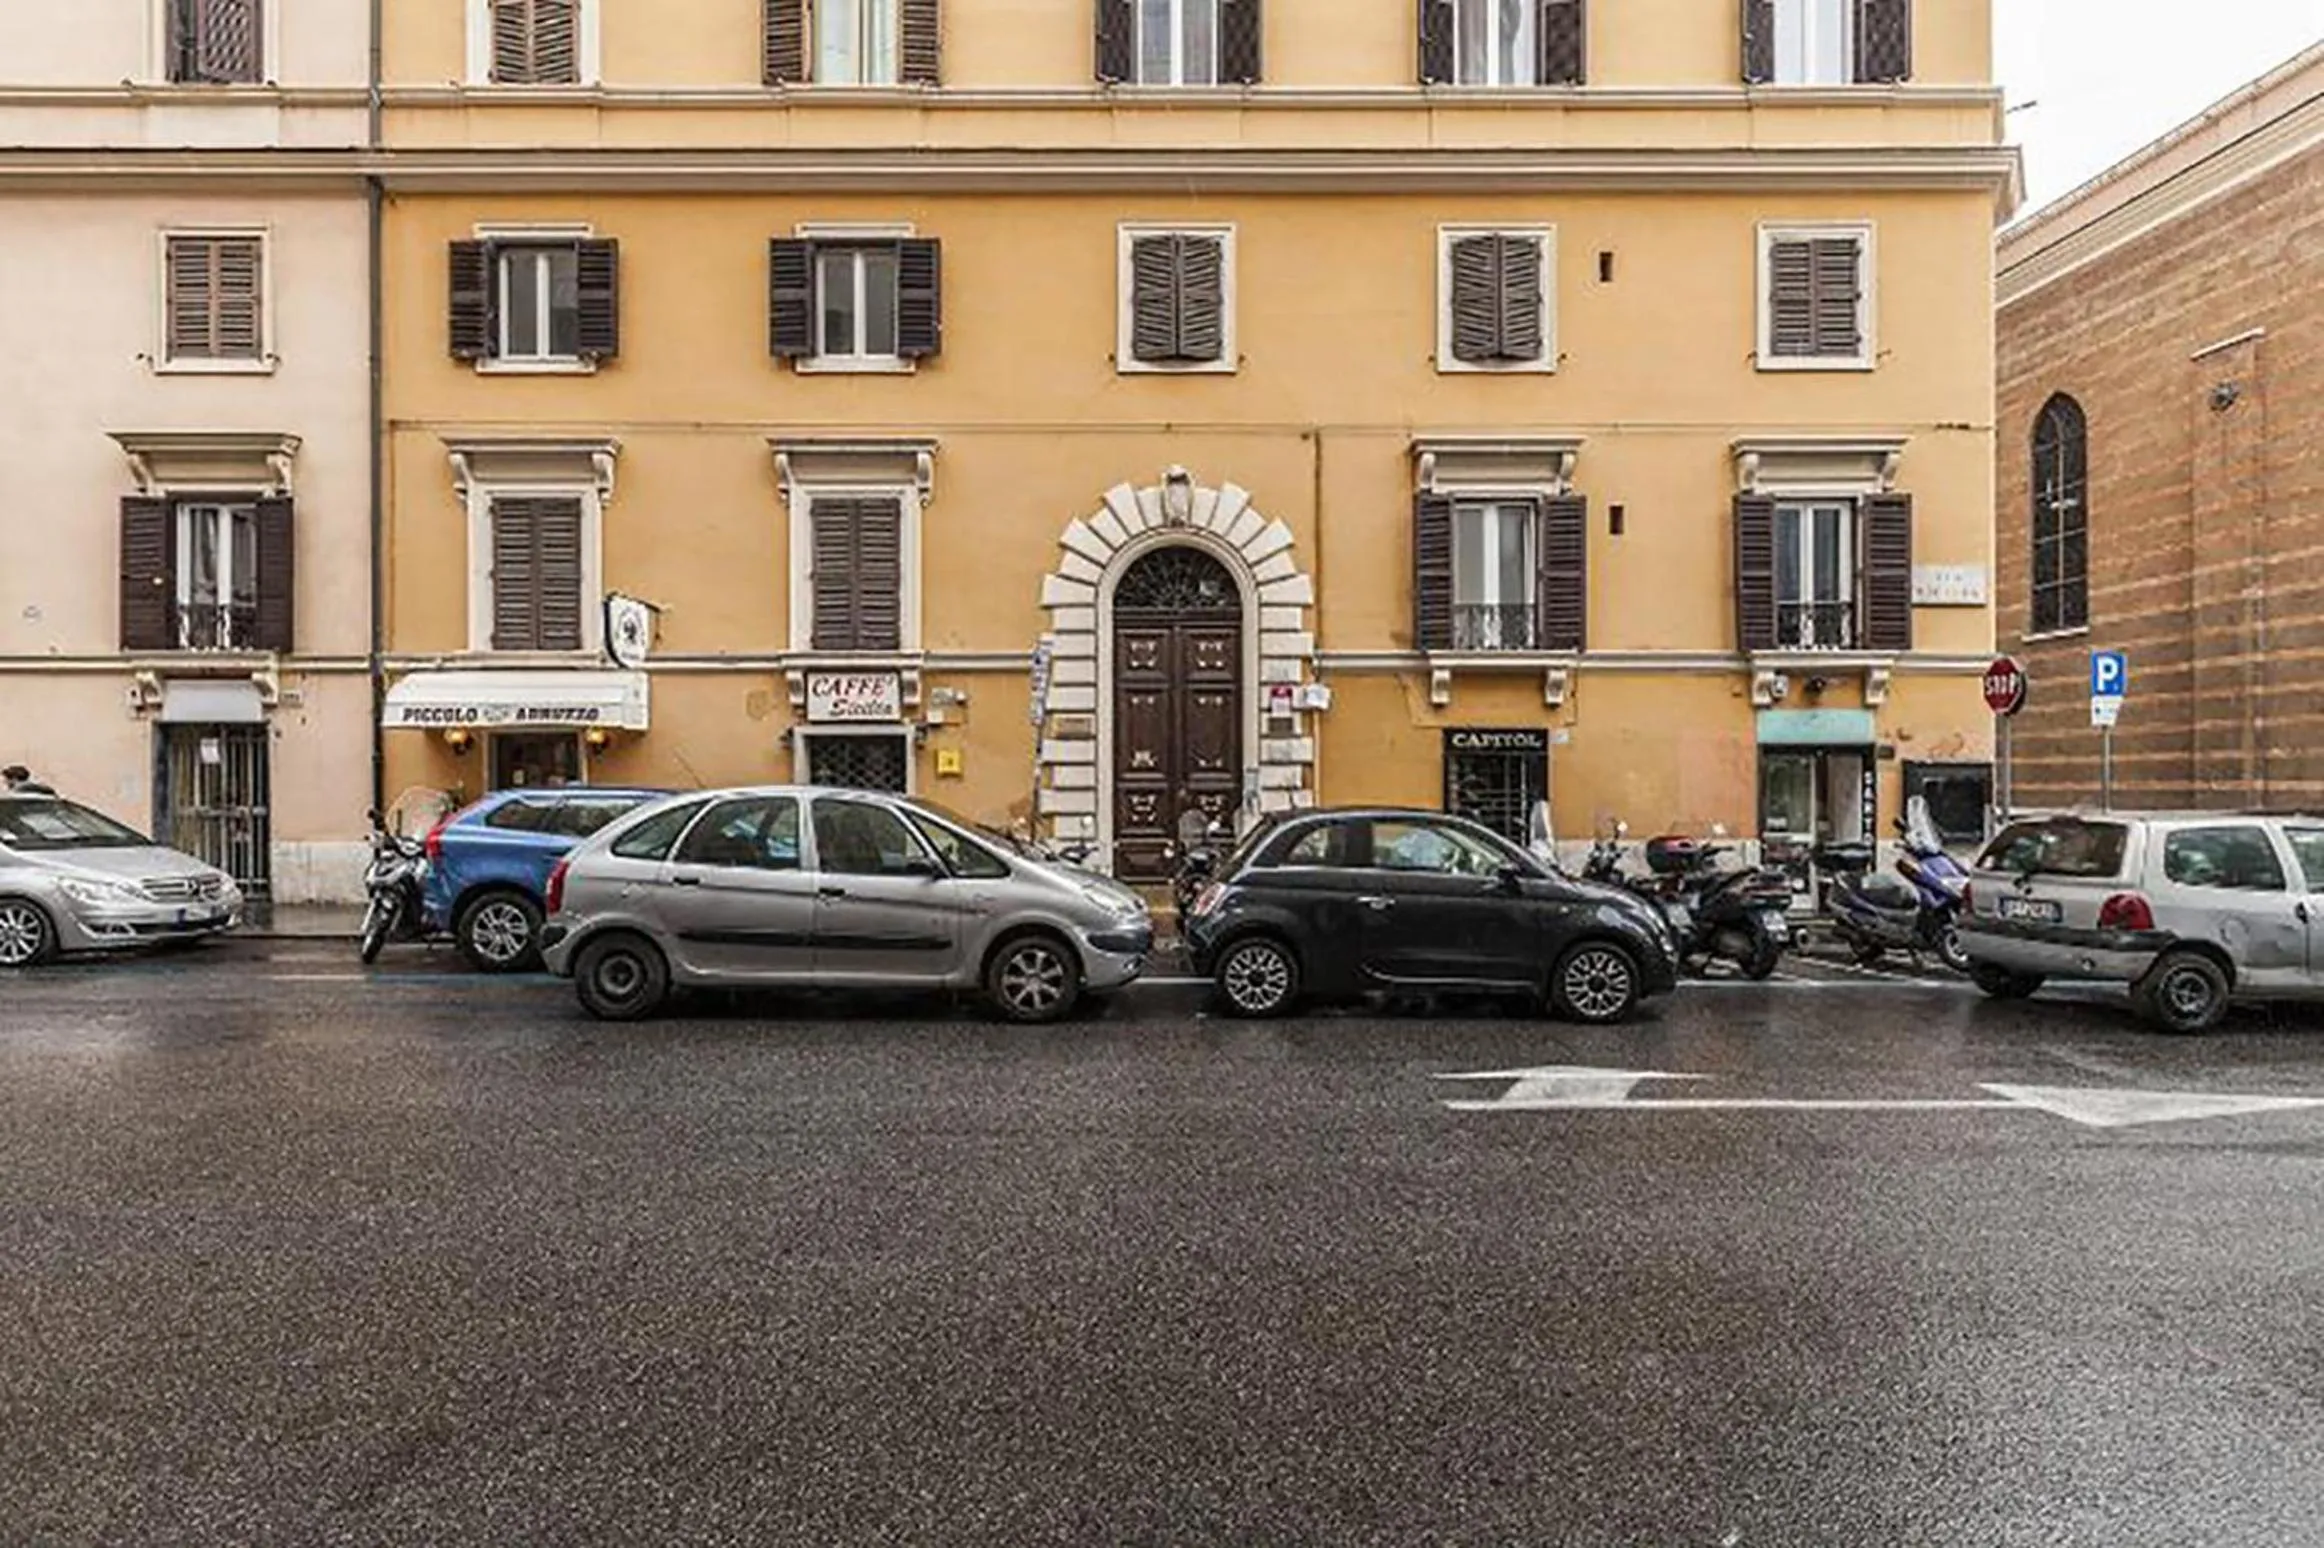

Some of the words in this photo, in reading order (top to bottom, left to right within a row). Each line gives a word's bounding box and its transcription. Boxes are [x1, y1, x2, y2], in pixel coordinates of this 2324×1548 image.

[2097, 657, 2118, 691] P
[402, 707, 478, 722] PICCOLO
[515, 707, 600, 721] ABRUZZO
[1452, 732, 1543, 748] CAPITOL
